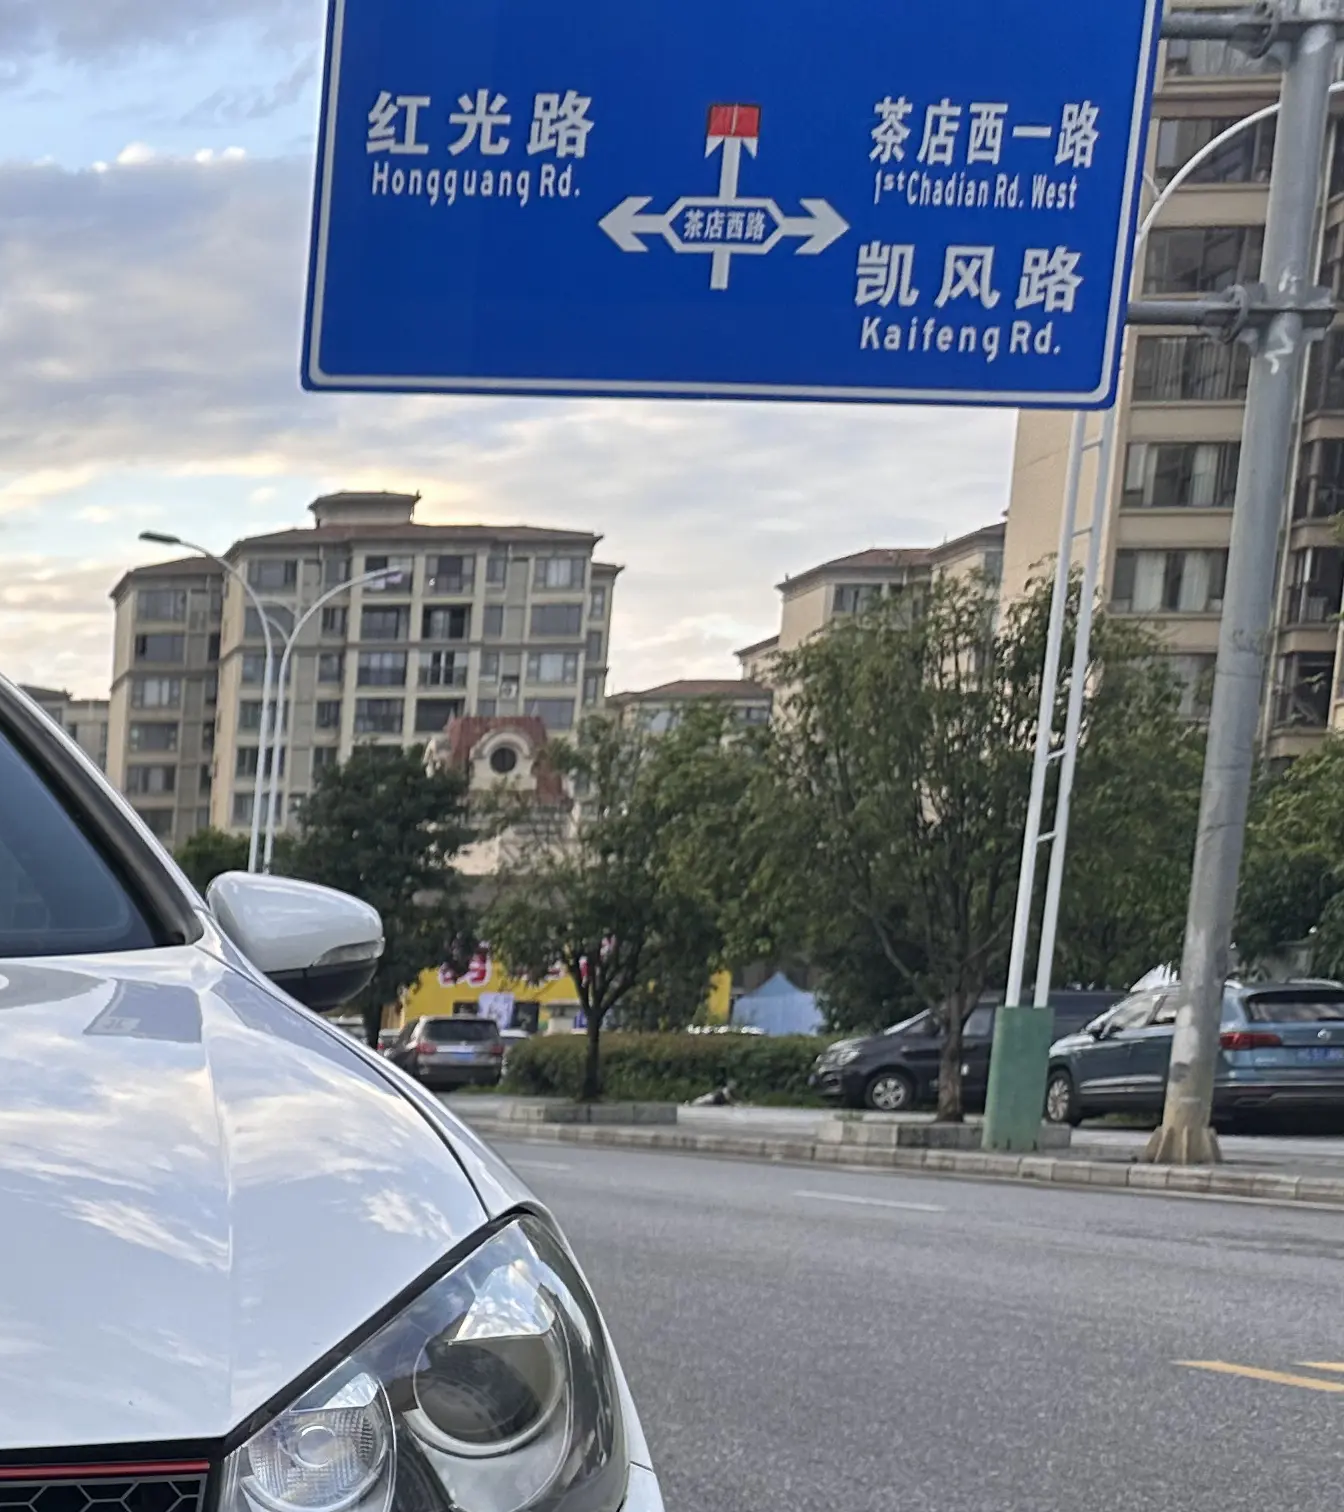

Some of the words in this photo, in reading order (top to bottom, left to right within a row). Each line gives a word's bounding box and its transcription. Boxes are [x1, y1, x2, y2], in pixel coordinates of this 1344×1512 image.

[366, 88, 594, 158] 红光路
[868, 95, 1100, 168] 茶店西一路
[371, 160, 530, 206] Hongguang
[539, 163, 580, 198] Rd.
[993, 172, 1024, 209] Rd.
[1031, 173, 1078, 209] West
[683, 208, 766, 241] 茶店西路
[854, 240, 1084, 313] 凯风路
[860, 315, 1001, 363] Kaifeng
[1009, 320, 1061, 355] Rd.
